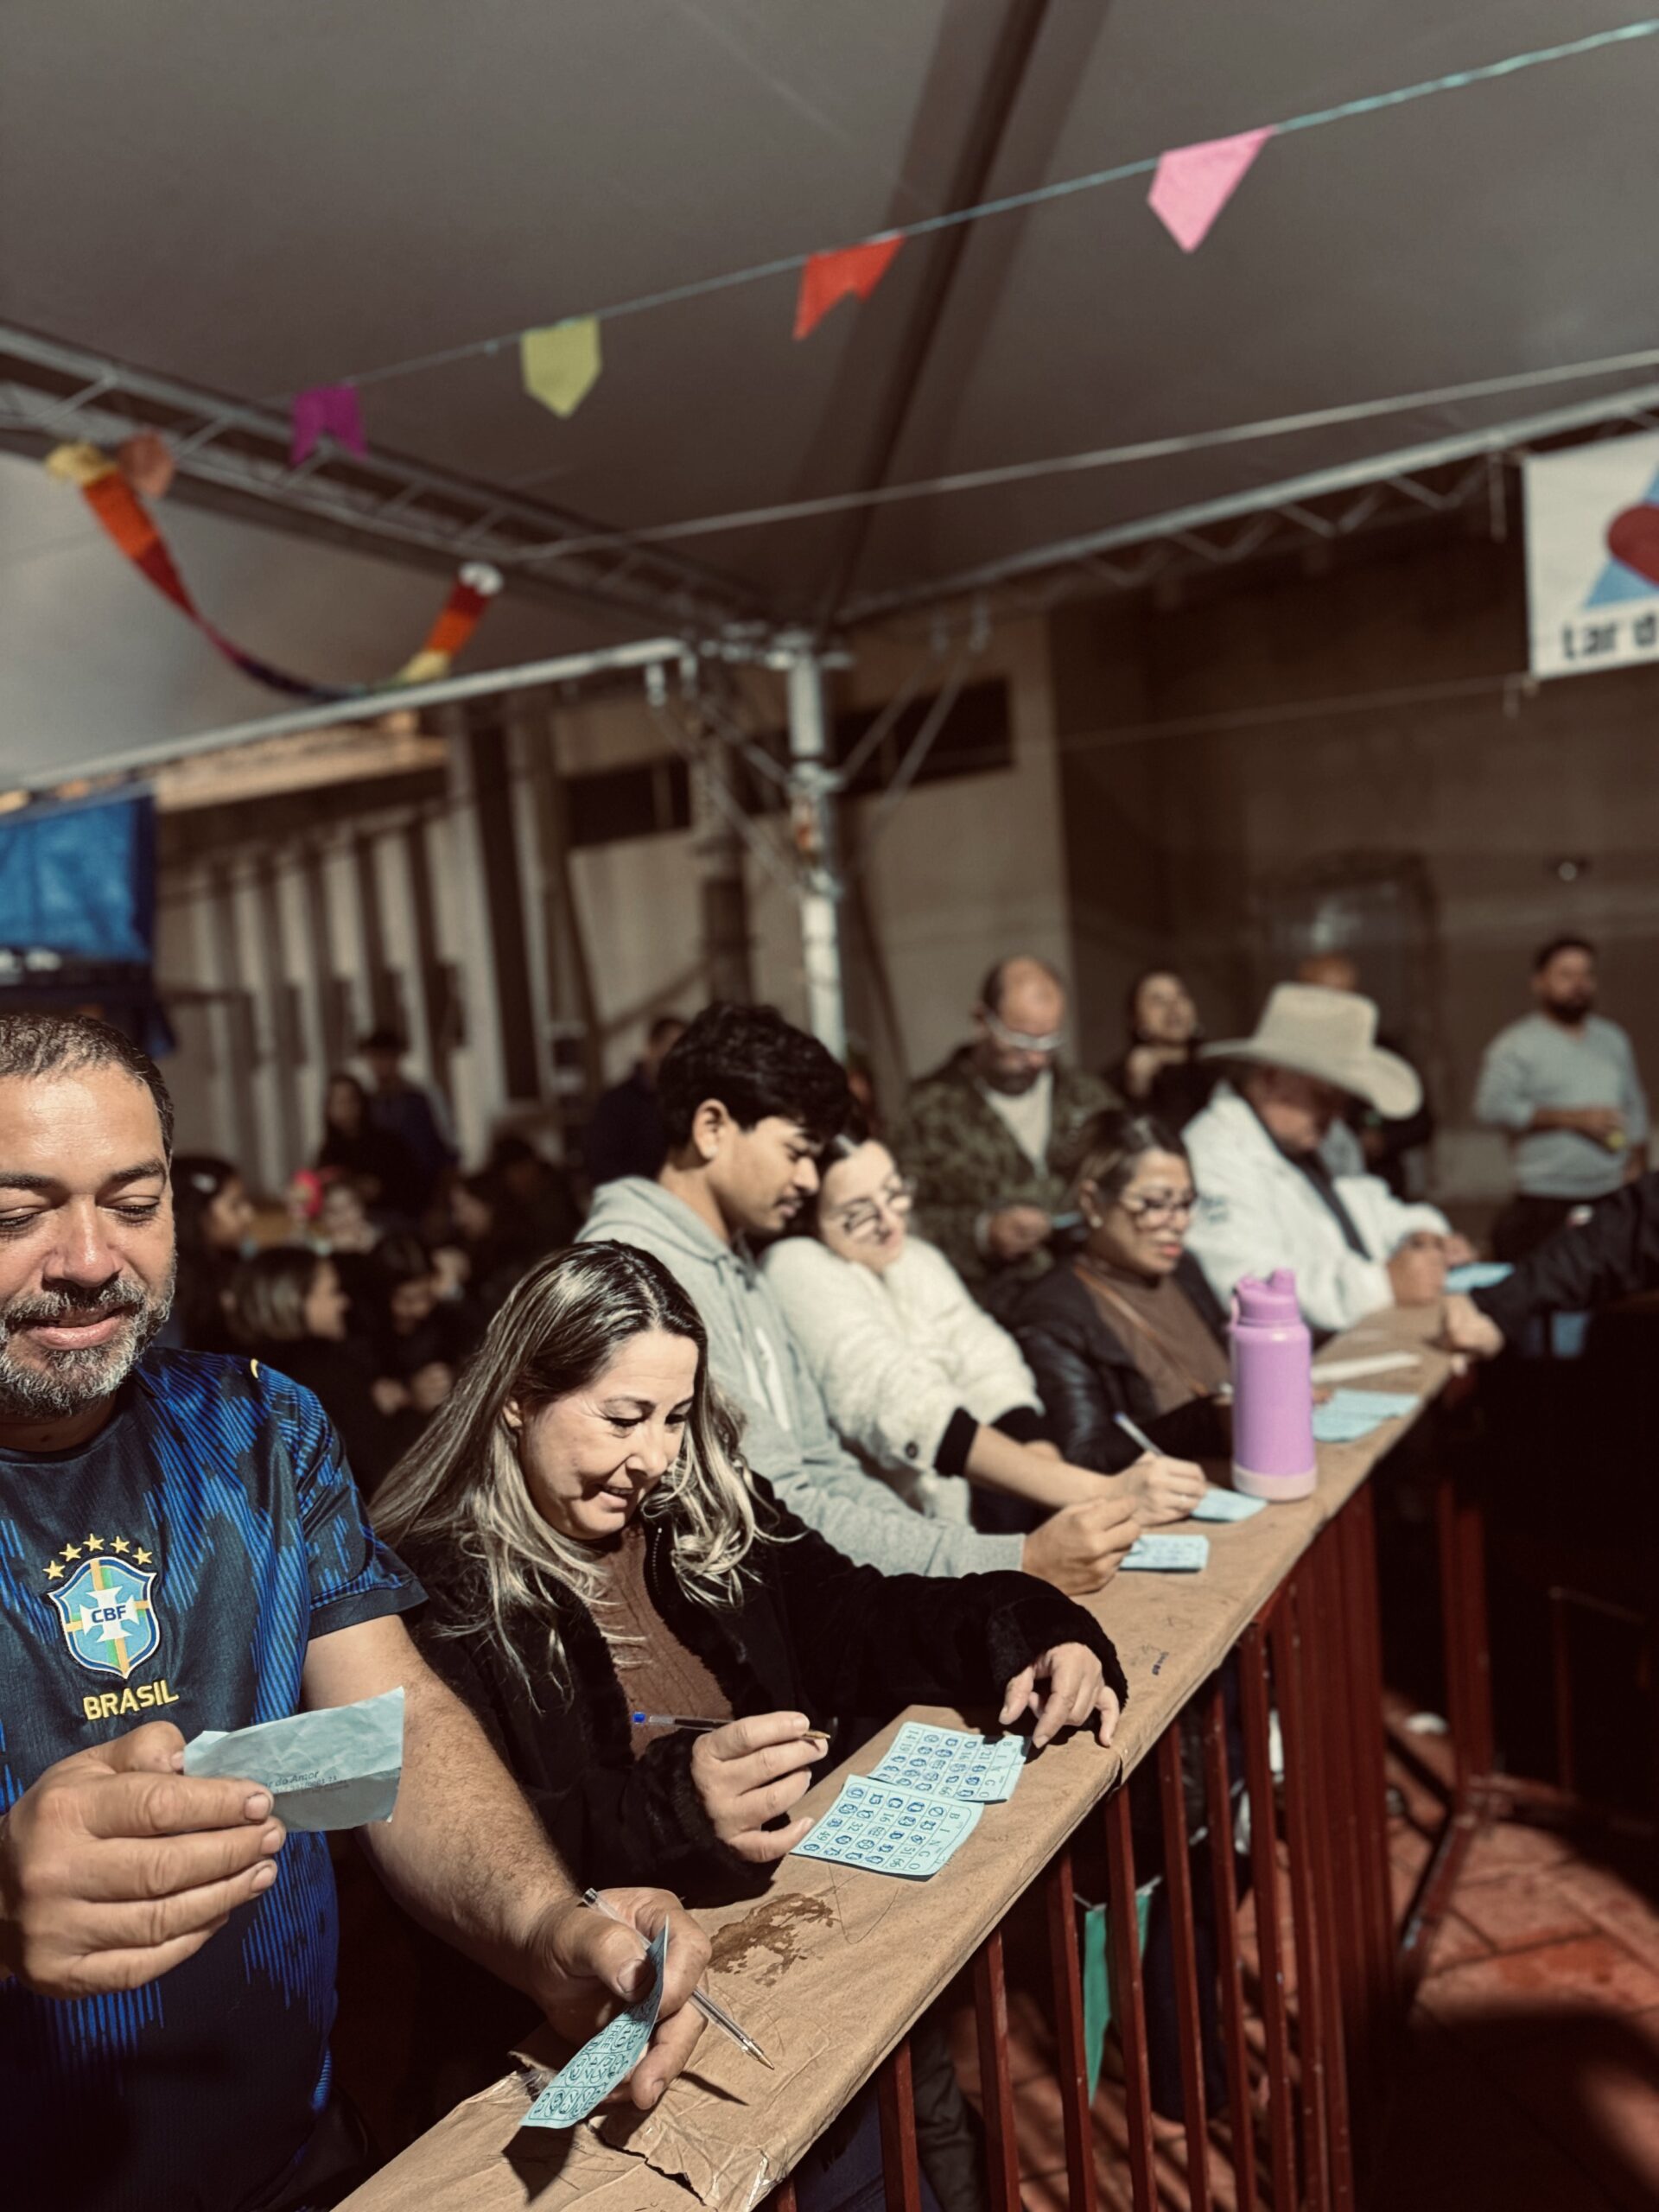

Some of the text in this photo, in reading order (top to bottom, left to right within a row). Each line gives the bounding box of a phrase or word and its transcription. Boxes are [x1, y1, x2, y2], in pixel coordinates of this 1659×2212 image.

[91, 1604, 127, 1624] CBF
[83, 1679, 179, 1720] BRASIL
[878, 1812, 894, 1822] 16
[847, 1821, 863, 1831] 32
[815, 1831, 830, 1840] 49
[900, 1847, 914, 1855] 51
[601, 2024, 622, 2049] FREE
